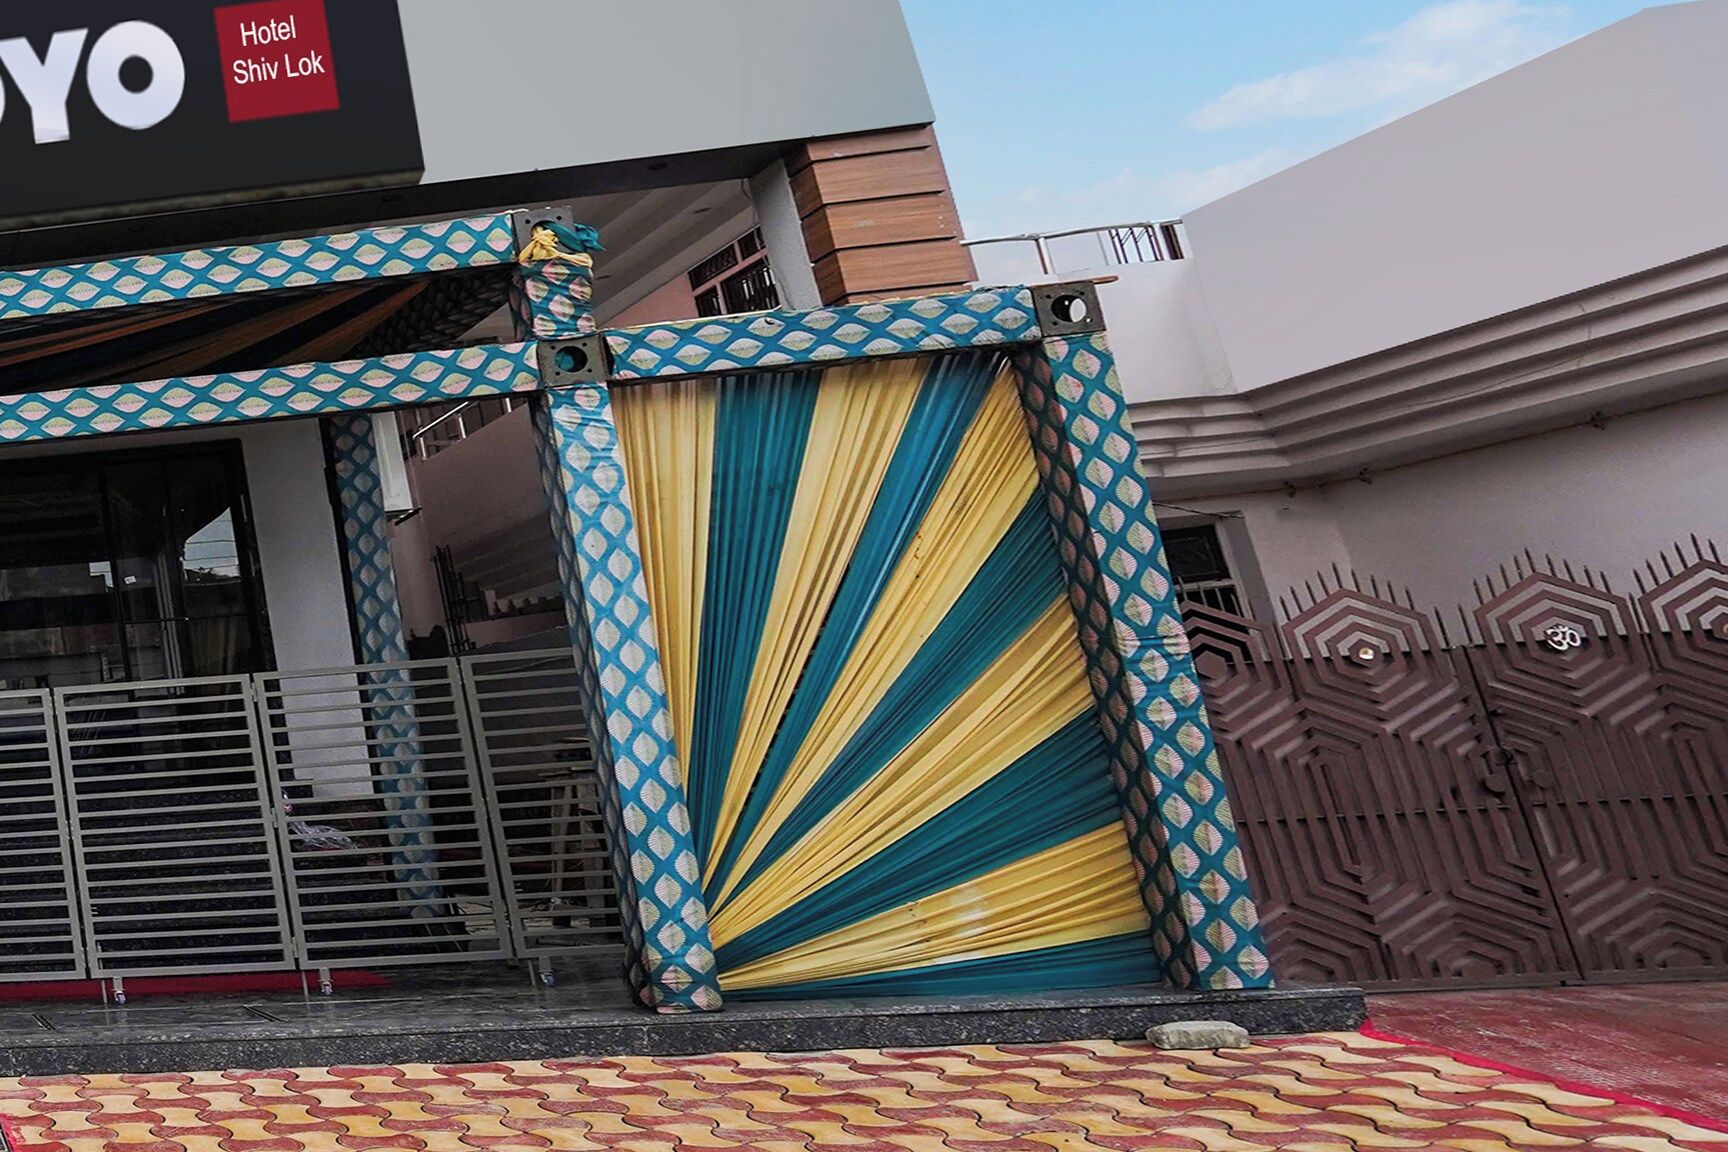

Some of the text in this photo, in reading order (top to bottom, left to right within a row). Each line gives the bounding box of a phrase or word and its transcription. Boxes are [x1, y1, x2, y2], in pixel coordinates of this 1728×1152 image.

[240, 15, 297, 47] Hotel
[233, 50, 326, 85] Shiv Lok
